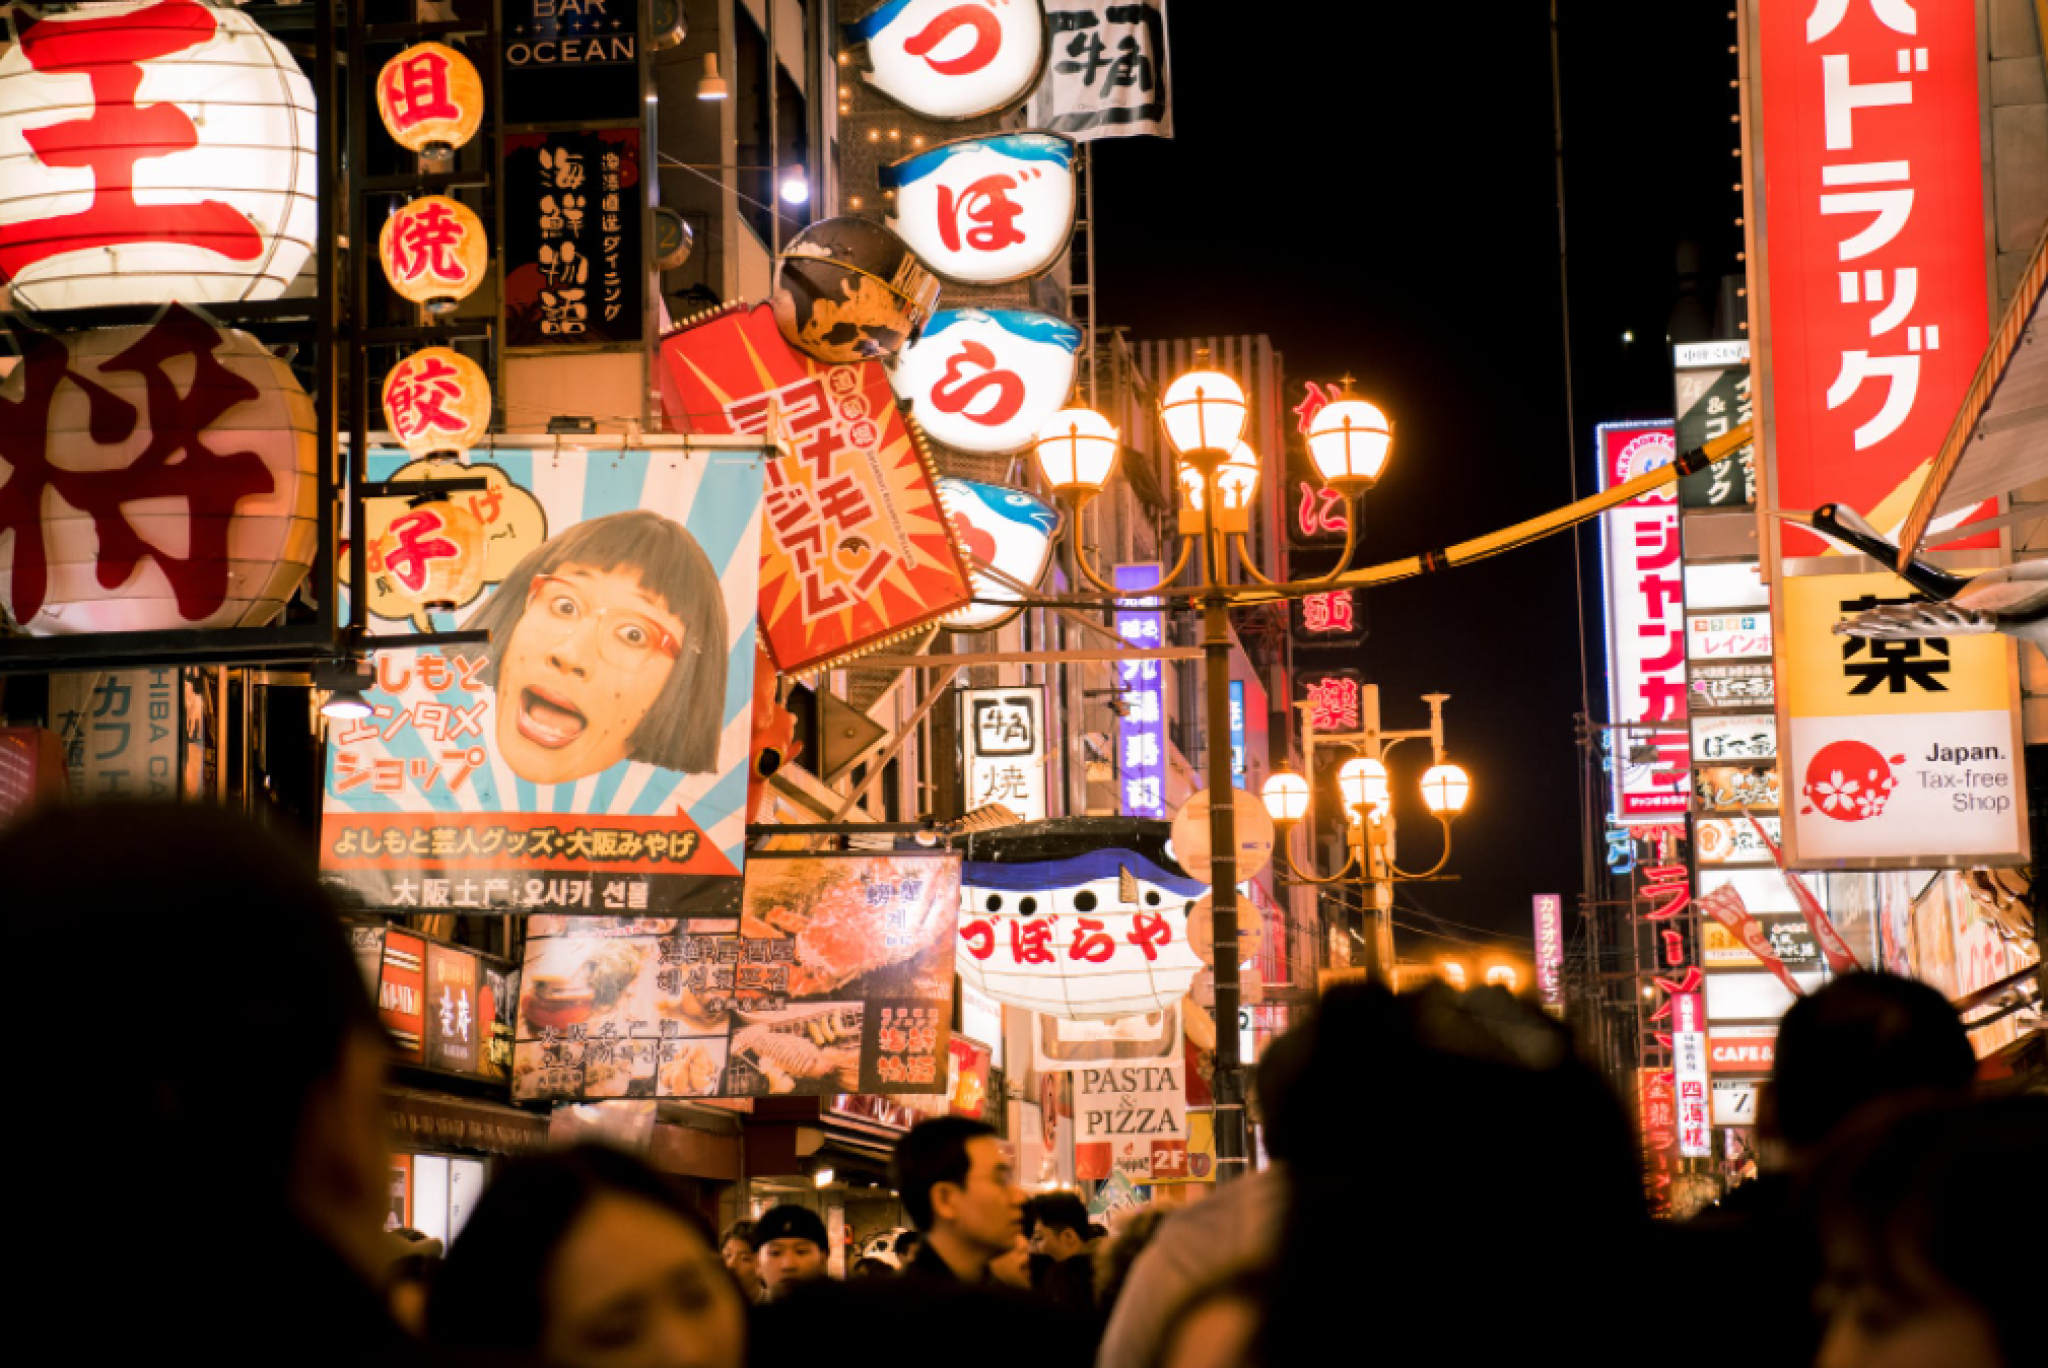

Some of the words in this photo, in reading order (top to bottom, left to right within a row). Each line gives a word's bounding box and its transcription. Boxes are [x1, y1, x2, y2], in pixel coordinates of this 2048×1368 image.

[506, 36, 634, 66] OCEAN
[1053, 32, 1153, 98] 牛角
[372, 653, 490, 694] しもと
[982, 708, 1028, 743] 牛角
[1925, 742, 2006, 765] Japan.
[332, 748, 488, 794] ショップ
[1917, 770, 2009, 791] Tax-free
[1952, 792, 2010, 815] Shop
[959, 912, 1173, 965] づぼらや
[1713, 1046, 1759, 1063] CAFE
[1081, 1067, 1180, 1095] PASTA
[1085, 1107, 1180, 1136] PIZZA
[1154, 1150, 1185, 1170] 2F
